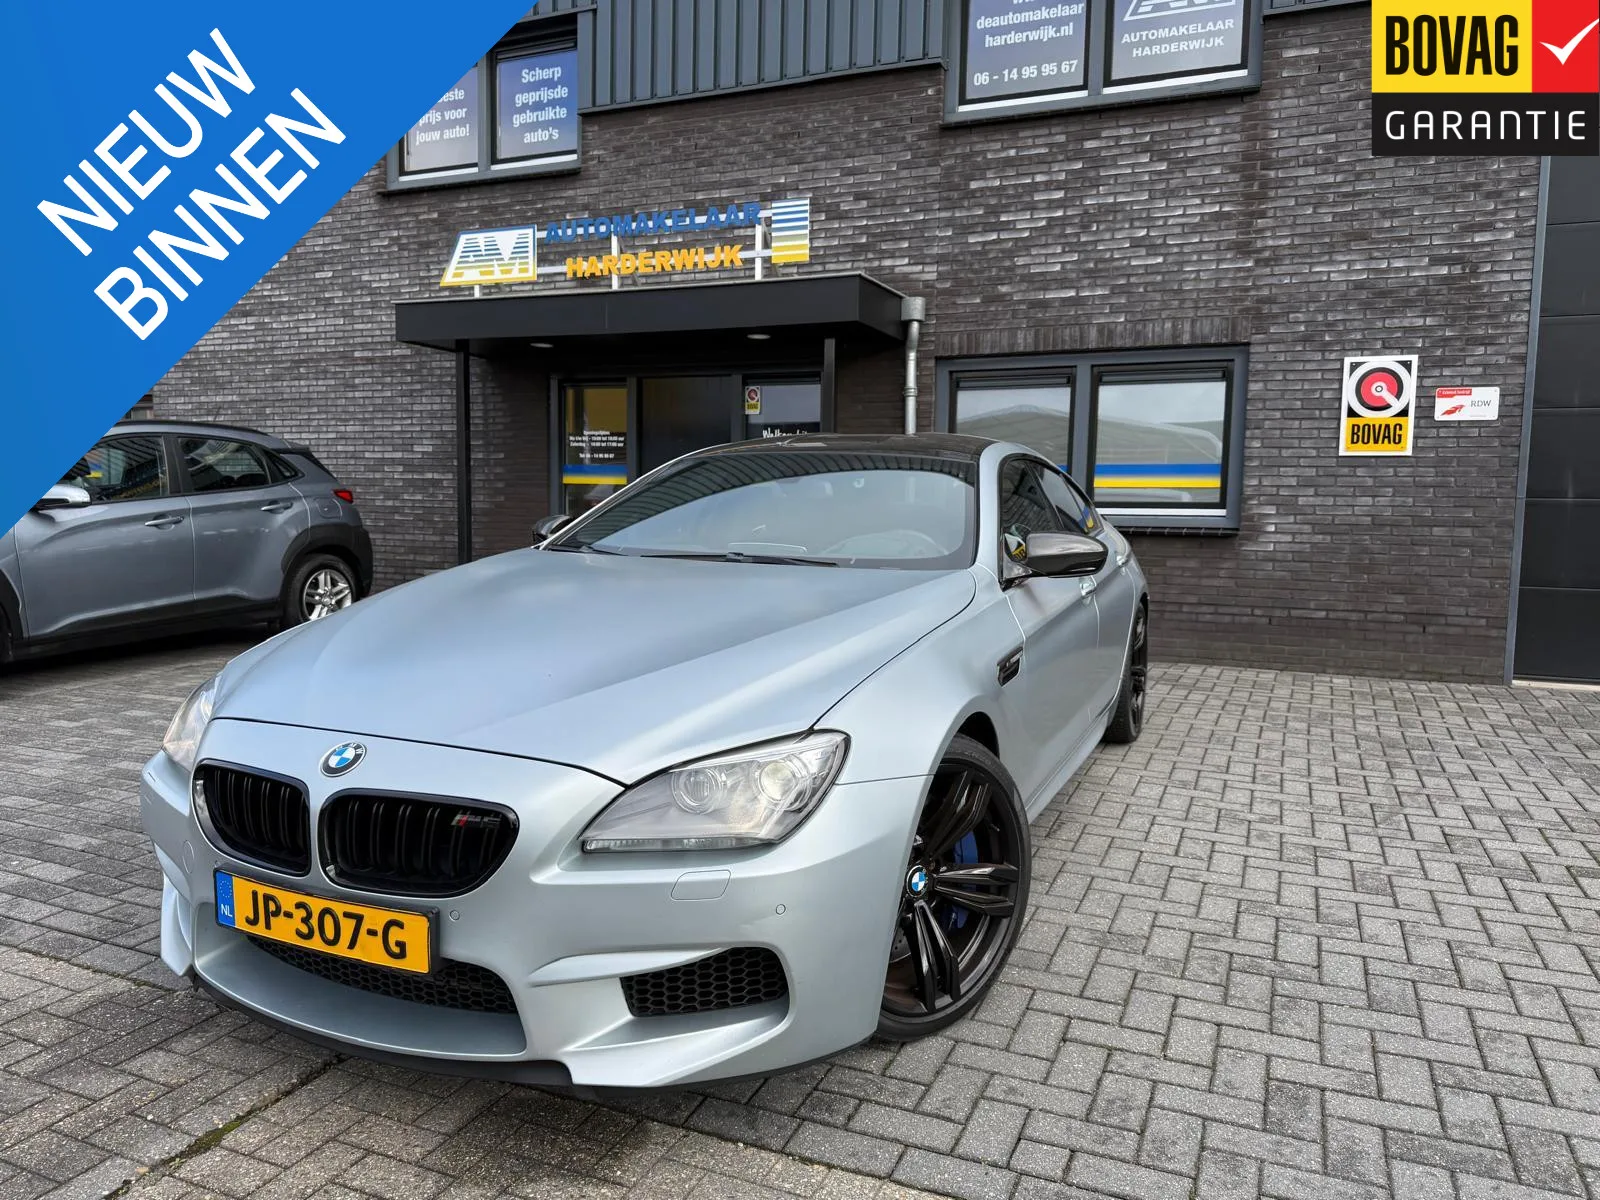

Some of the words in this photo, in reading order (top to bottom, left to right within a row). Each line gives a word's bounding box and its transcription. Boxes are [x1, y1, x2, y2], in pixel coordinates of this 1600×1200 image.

[976, 3, 1084, 30] deautomakelaar
[985, 22, 1073, 47] harderwijk.nl
[1121, 19, 1235, 43] AUTOMAKELAAR
[1132, 36, 1225, 57] HARDERWIJK
[521, 66, 562, 83] Scherp
[973, 71, 990, 86] 06
[1002, 68, 1018, 83] 14
[1021, 65, 1038, 80] 95
[1040, 62, 1057, 77] 95
[1060, 60, 1079, 74] 67
[437, 88, 465, 102] este
[515, 85, 568, 107] geprijsde
[444, 107, 468, 121] voor
[513, 106, 567, 128] gebruikte
[415, 130, 440, 146] jouw
[443, 124, 470, 140] auto!
[523, 128, 560, 144] auto's
[544, 202, 761, 244] AUTOMAKELAAR
[565, 244, 744, 279] HARDERWIJK
[1470, 399, 1492, 408] RDW
[1350, 423, 1403, 445] BOVAG
[220, 903, 233, 918] NL
[244, 889, 407, 960] JP-307-G
